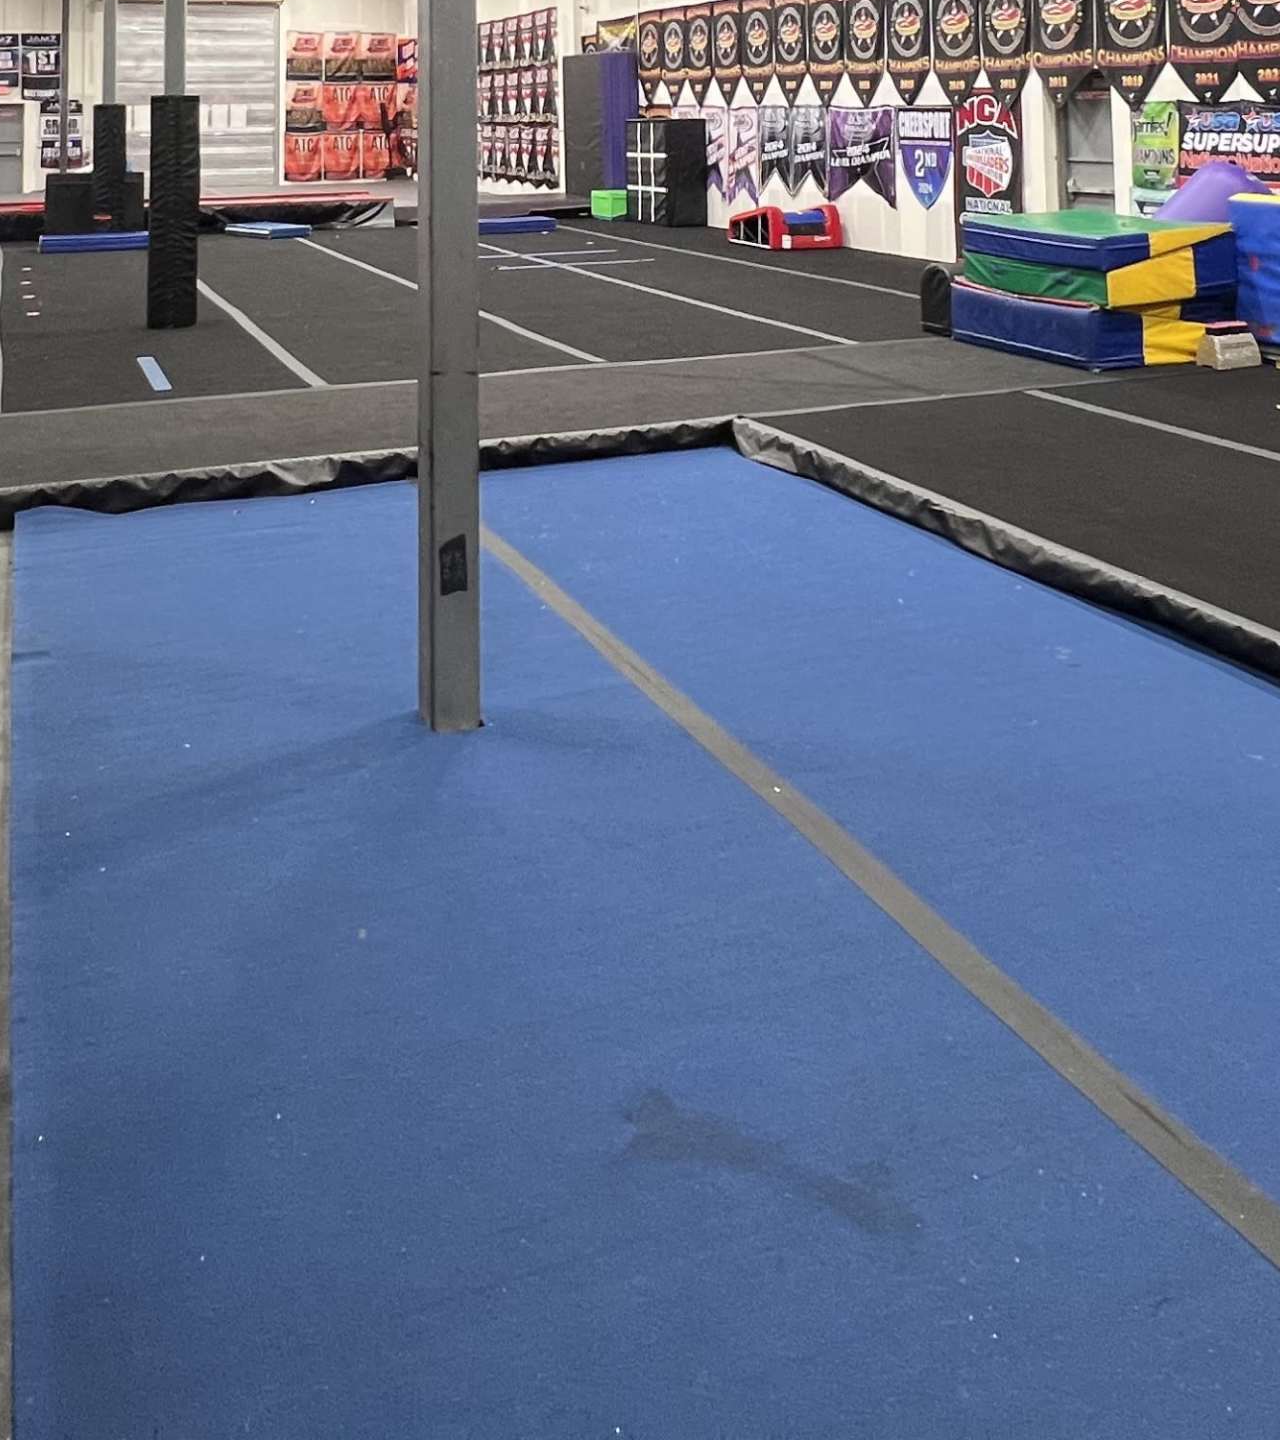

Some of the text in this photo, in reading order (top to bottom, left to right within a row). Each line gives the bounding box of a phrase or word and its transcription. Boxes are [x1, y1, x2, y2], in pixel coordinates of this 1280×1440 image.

[26, 34, 58, 44] JAMZ
[26, 49, 58, 75] 1ST
[333, 86, 352, 102] ATC
[898, 111, 951, 139] CHEERSPORT
[956, 94, 1019, 139] NCA
[294, 138, 314, 153] ATC
[333, 136, 352, 151] ATC
[914, 149, 938, 177] 2ND
